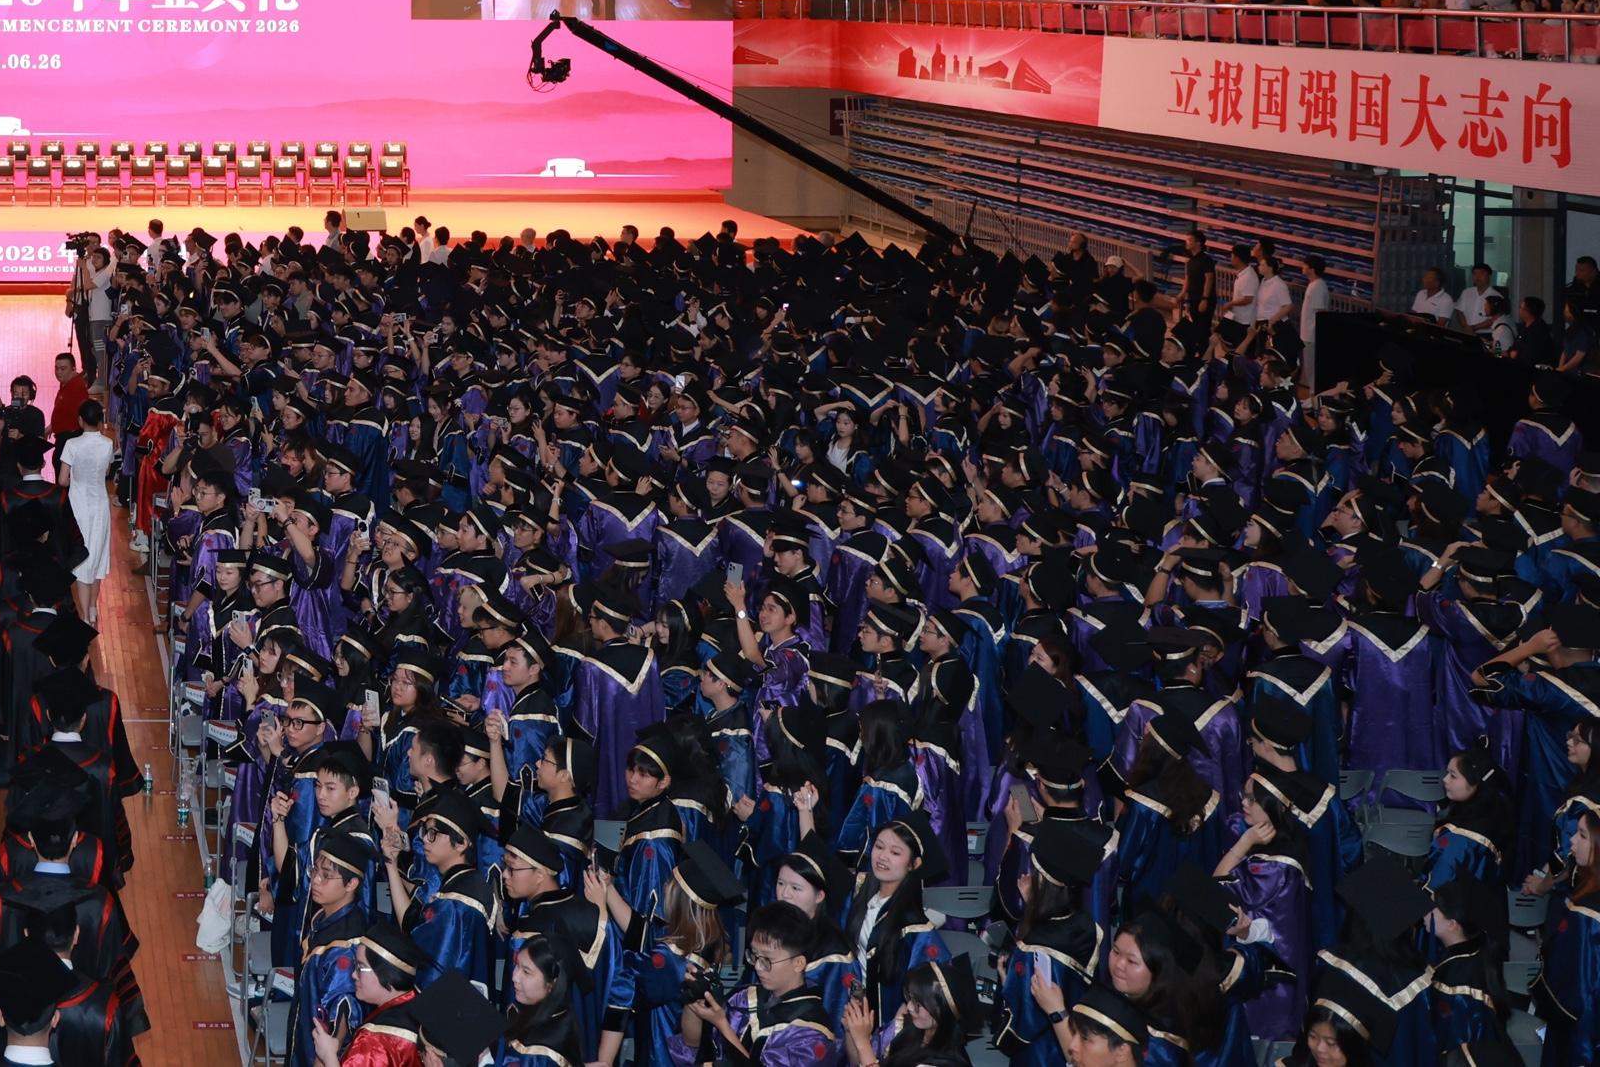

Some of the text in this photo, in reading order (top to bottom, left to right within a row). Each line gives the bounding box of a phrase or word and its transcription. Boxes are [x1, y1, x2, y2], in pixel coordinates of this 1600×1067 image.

[137, 18, 251, 33] CEREMONY
[255, 18, 300, 33] 2026
[1169, 56, 1574, 170] 立报国强国大志向
